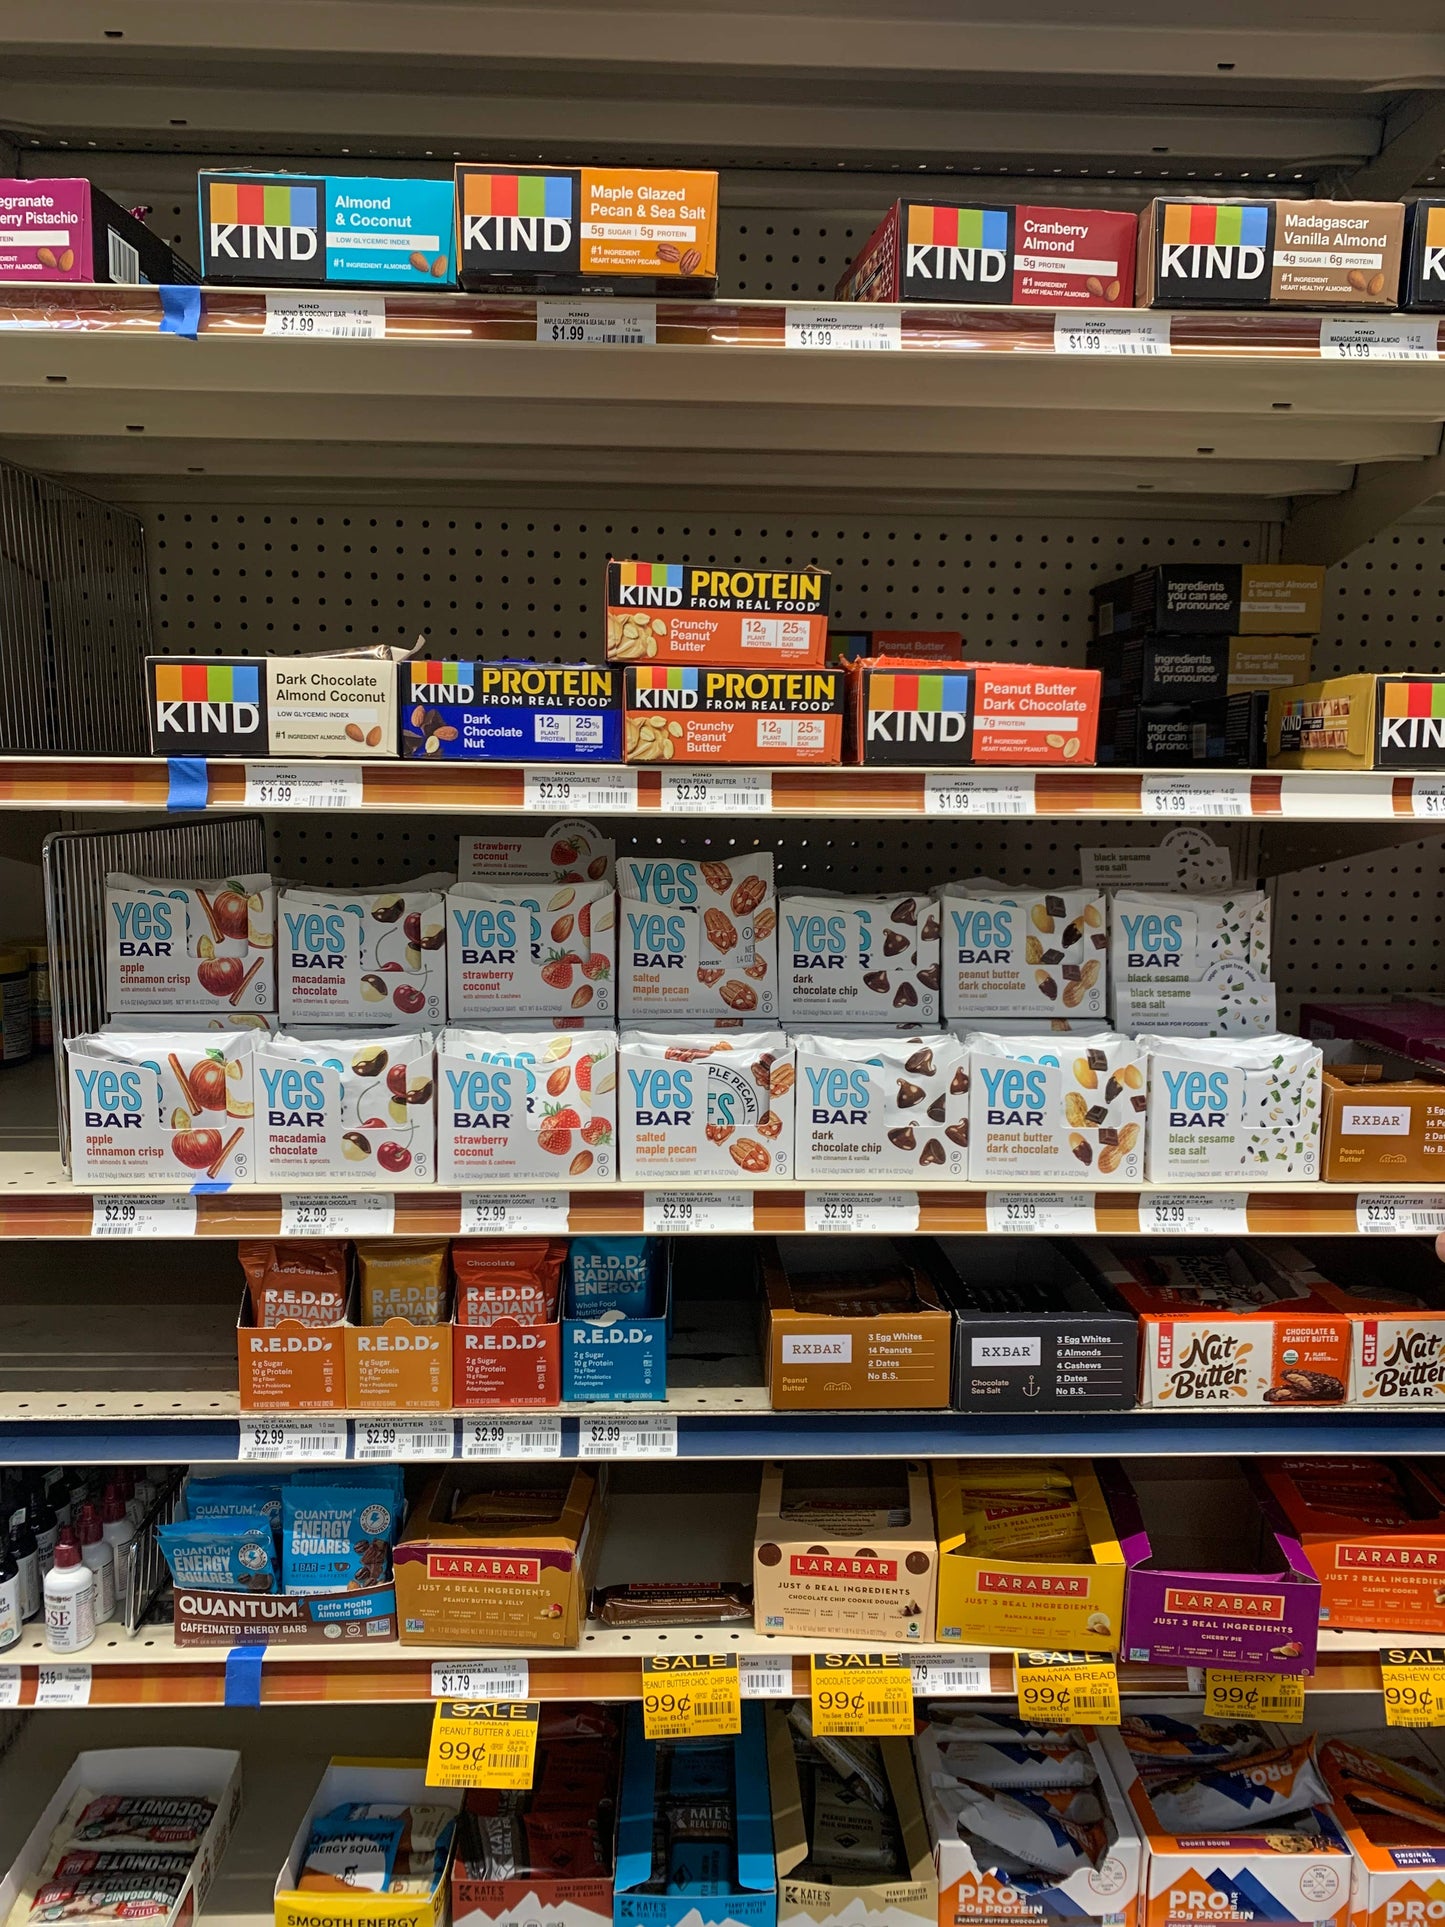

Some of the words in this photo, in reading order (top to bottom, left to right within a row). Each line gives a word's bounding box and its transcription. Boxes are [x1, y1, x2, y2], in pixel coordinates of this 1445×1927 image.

[591, 185, 633, 202] Maple
[638, 187, 685, 201] Glazed
[335, 196, 390, 210] Almond
[26, 212, 78, 224] Pistachio
[591, 204, 632, 218] Pecan
[637, 205, 646, 217] &
[651, 206, 675, 219] Sea
[680, 206, 706, 220] Salt
[336, 214, 345, 225] &
[350, 213, 411, 227] Coconut
[1285, 215, 1369, 231] Madagascar
[464, 216, 572, 252] KIND
[1024, 220, 1088, 238] Cranberry
[210, 223, 317, 260] KIND
[353, 237, 387, 245] GLYCEMIC
[1024, 238, 1075, 252] Almond
[1284, 232, 1329, 246] Vanilla
[1334, 232, 1386, 247] Almond
[334, 259, 345, 268] #1
[906, 244, 1007, 282] KIND
[1160, 244, 1266, 280] KIND
[1283, 254, 1295, 264] 4g
[1329, 255, 1342, 265] 6g
[281, 317, 313, 332] $1.99
[552, 325, 584, 341] $1.99
[801, 330, 831, 346] $1.99
[619, 585, 683, 607] KIND
[691, 570, 821, 601] PROTEIN
[1168, 581, 1224, 593] ingredients
[1168, 592, 1183, 601] you
[1186, 592, 1206, 601] can
[1209, 592, 1228, 601] see
[1176, 602, 1230, 611] pronounce
[671, 619, 718, 631] Crunchy
[671, 630, 710, 641] Peanut
[671, 641, 706, 651] Butter
[276, 673, 306, 685] Dark
[311, 674, 377, 686] Chocolate
[411, 684, 475, 703] KIND
[483, 668, 612, 696] PROTEIN
[984, 683, 1030, 695] Peanut
[1035, 683, 1077, 695] Butter
[276, 689, 325, 702] Almond
[330, 690, 386, 703] Coconut
[483, 697, 523, 705] FROM
[529, 697, 563, 706] REAL
[569, 698, 608, 707] FOOD
[984, 699, 1015, 711] Dark
[1019, 700, 1086, 711] Chocolate
[157, 701, 260, 733] KIND
[464, 714, 491, 724] Dark
[464, 726, 523, 737] Chocolate
[867, 711, 966, 742] KIND
[464, 738, 485, 748] Nut
[260, 787, 292, 802] $1.99
[540, 783, 570, 799] $2.39
[677, 785, 706, 800] $2.39
[462, 970, 514, 982] strawberry
[462, 982, 500, 991] coconut
[85, 1112, 142, 1128] BAR
[1352, 1115, 1400, 1126] RXBAR
[86, 1135, 112, 1145] apple
[636, 1132, 666, 1143] salted
[812, 1131, 833, 1140] dark
[1169, 1134, 1195, 1143] black
[1198, 1135, 1235, 1143] sesame
[86, 1146, 135, 1157] cinnamon
[138, 1146, 164, 1158] crisp
[636, 1144, 665, 1155] maple
[668, 1145, 697, 1155] pecan
[812, 1143, 859, 1152] chocolate
[861, 1143, 882, 1154] chip
[1169, 1147, 1187, 1155] sea
[1189, 1145, 1206, 1155] salt
[824, 1203, 853, 1219] $2.99
[1368, 1206, 1395, 1221] $2.39
[1065, 1337, 1079, 1345] Egg
[1081, 1335, 1111, 1343] Whites
[982, 1348, 1031, 1357] RXBAR
[1057, 1349, 1062, 1357] 6
[1160, 1335, 1172, 1365] CLIF
[1180, 1334, 1238, 1368] Nut
[1171, 1363, 1247, 1399] Butter
[1195, 1389, 1229, 1399] BAR
[255, 1430, 284, 1445] $2.99
[294, 1509, 352, 1520] QUANTUM
[293, 1520, 350, 1539] ENERGY
[292, 1539, 350, 1555] SQUARES
[417, 1584, 441, 1593] JUST
[445, 1585, 451, 1593] 4
[455, 1585, 480, 1594] REAL
[484, 1586, 551, 1597] INGREDIENTS
[317, 1603, 339, 1611] Caffe
[342, 1600, 372, 1610] Mocha
[788, 1594, 827, 1602] CHOCOLATE
[847, 1597, 874, 1605] COOKIE
[876, 1598, 899, 1606] DOUGH
[318, 1609, 350, 1618] Almond
[353, 1606, 372, 1616] Chip
[181, 1623, 241, 1634] CAFFEINATED
[244, 1624, 280, 1634] ENERGY
[283, 1624, 307, 1633] BARS
[651, 1654, 728, 1669] SALE
[1022, 1674, 1068, 1683] BANANA
[1073, 1672, 1116, 1682] BREAD
[441, 1676, 470, 1694] $1.79
[1024, 1688, 1071, 1709] 99¢
[440, 1728, 470, 1737] PEANUT
[473, 1728, 503, 1737] BUTTER
[505, 1729, 511, 1737] &
[512, 1729, 536, 1738] JELLY
[439, 1742, 486, 1766] 99¢
[801, 1889, 831, 1900] KATE'S
[1170, 1891, 1229, 1909] PRO
[1169, 1911, 1193, 1920] 20g
[1197, 1911, 1254, 1920] PROTEIN
